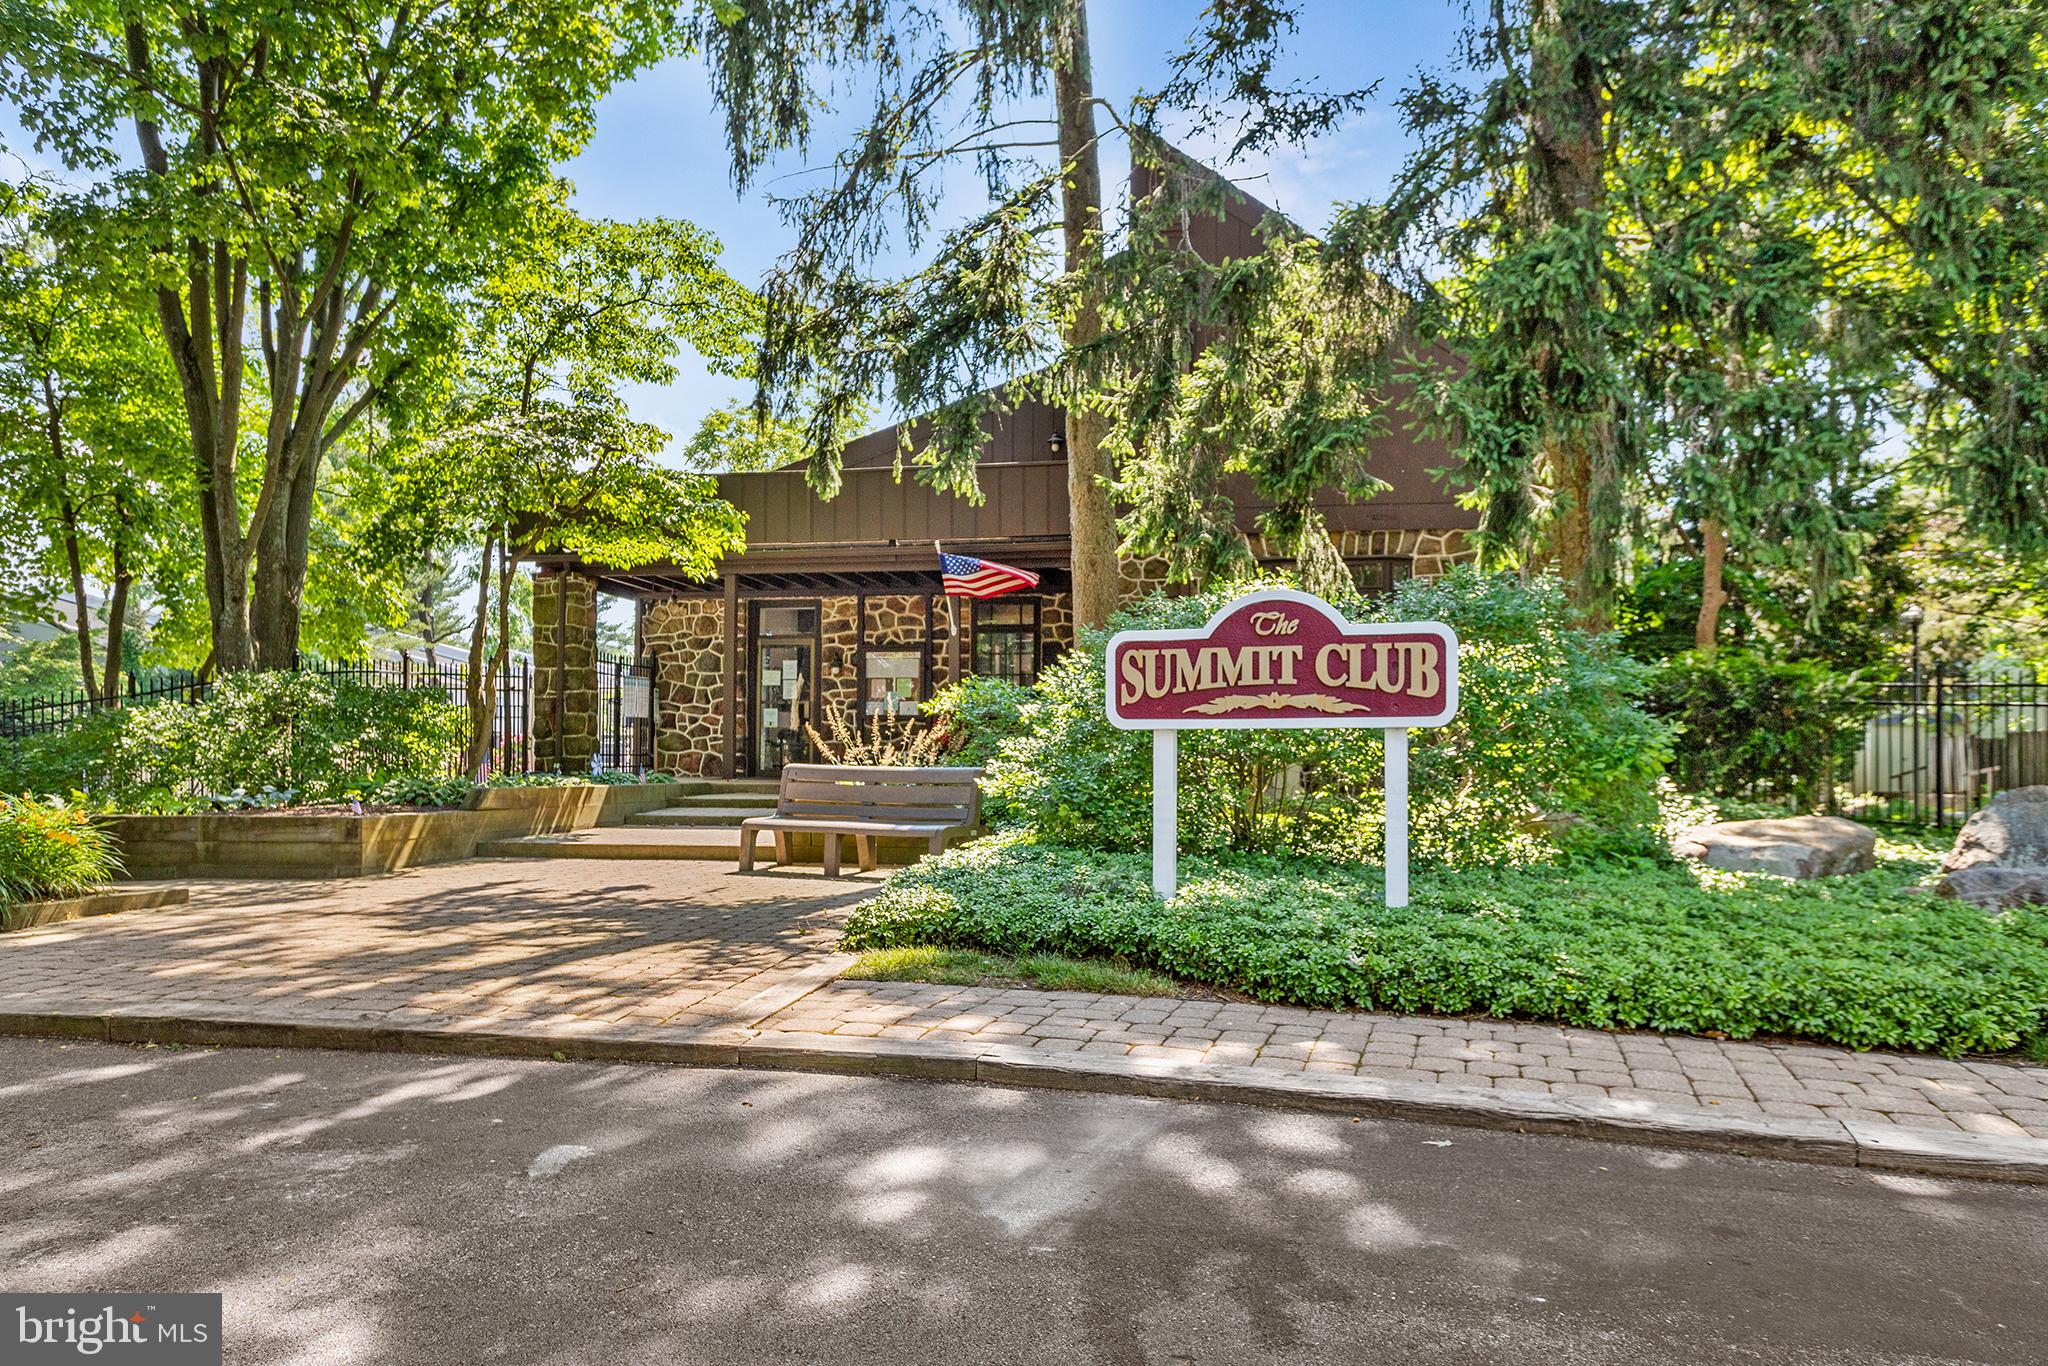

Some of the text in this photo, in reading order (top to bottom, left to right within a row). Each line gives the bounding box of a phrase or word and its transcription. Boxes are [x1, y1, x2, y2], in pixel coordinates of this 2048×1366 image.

[1250, 611, 1300, 637] The
[1120, 641, 1441, 706] SUMMIT CLUB
